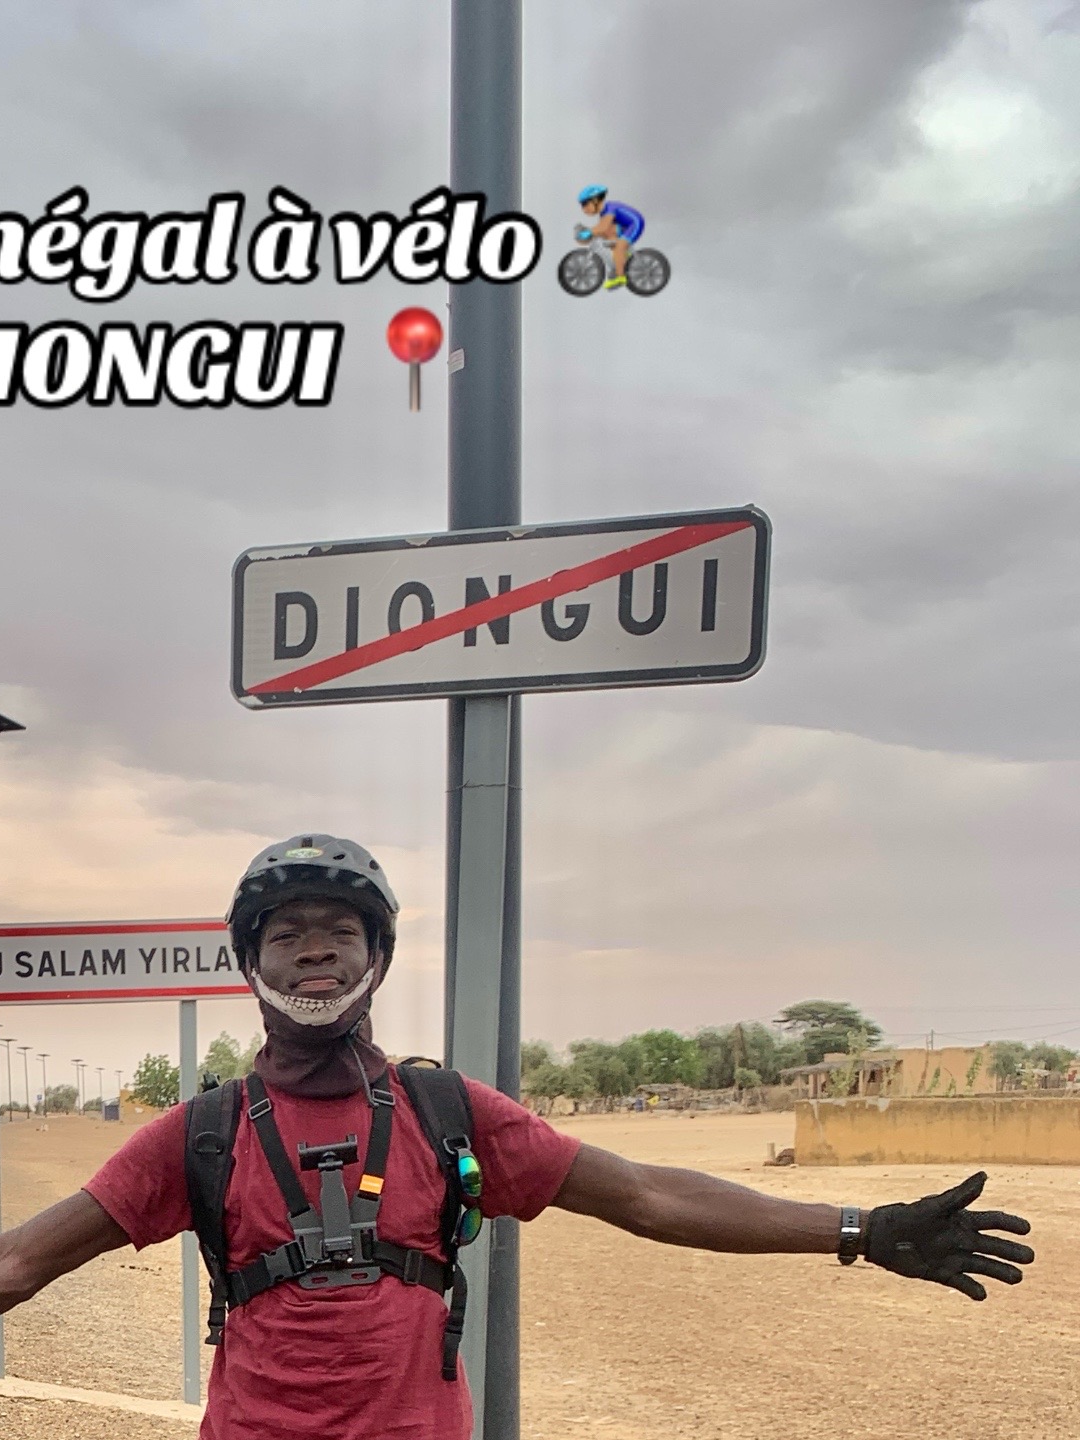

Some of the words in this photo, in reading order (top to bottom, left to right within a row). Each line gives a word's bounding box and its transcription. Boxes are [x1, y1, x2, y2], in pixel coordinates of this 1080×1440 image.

[272, 558, 720, 662] DIONGUI
[14, 947, 126, 979] SALAM
[138, 945, 242, 974] YIRLA
